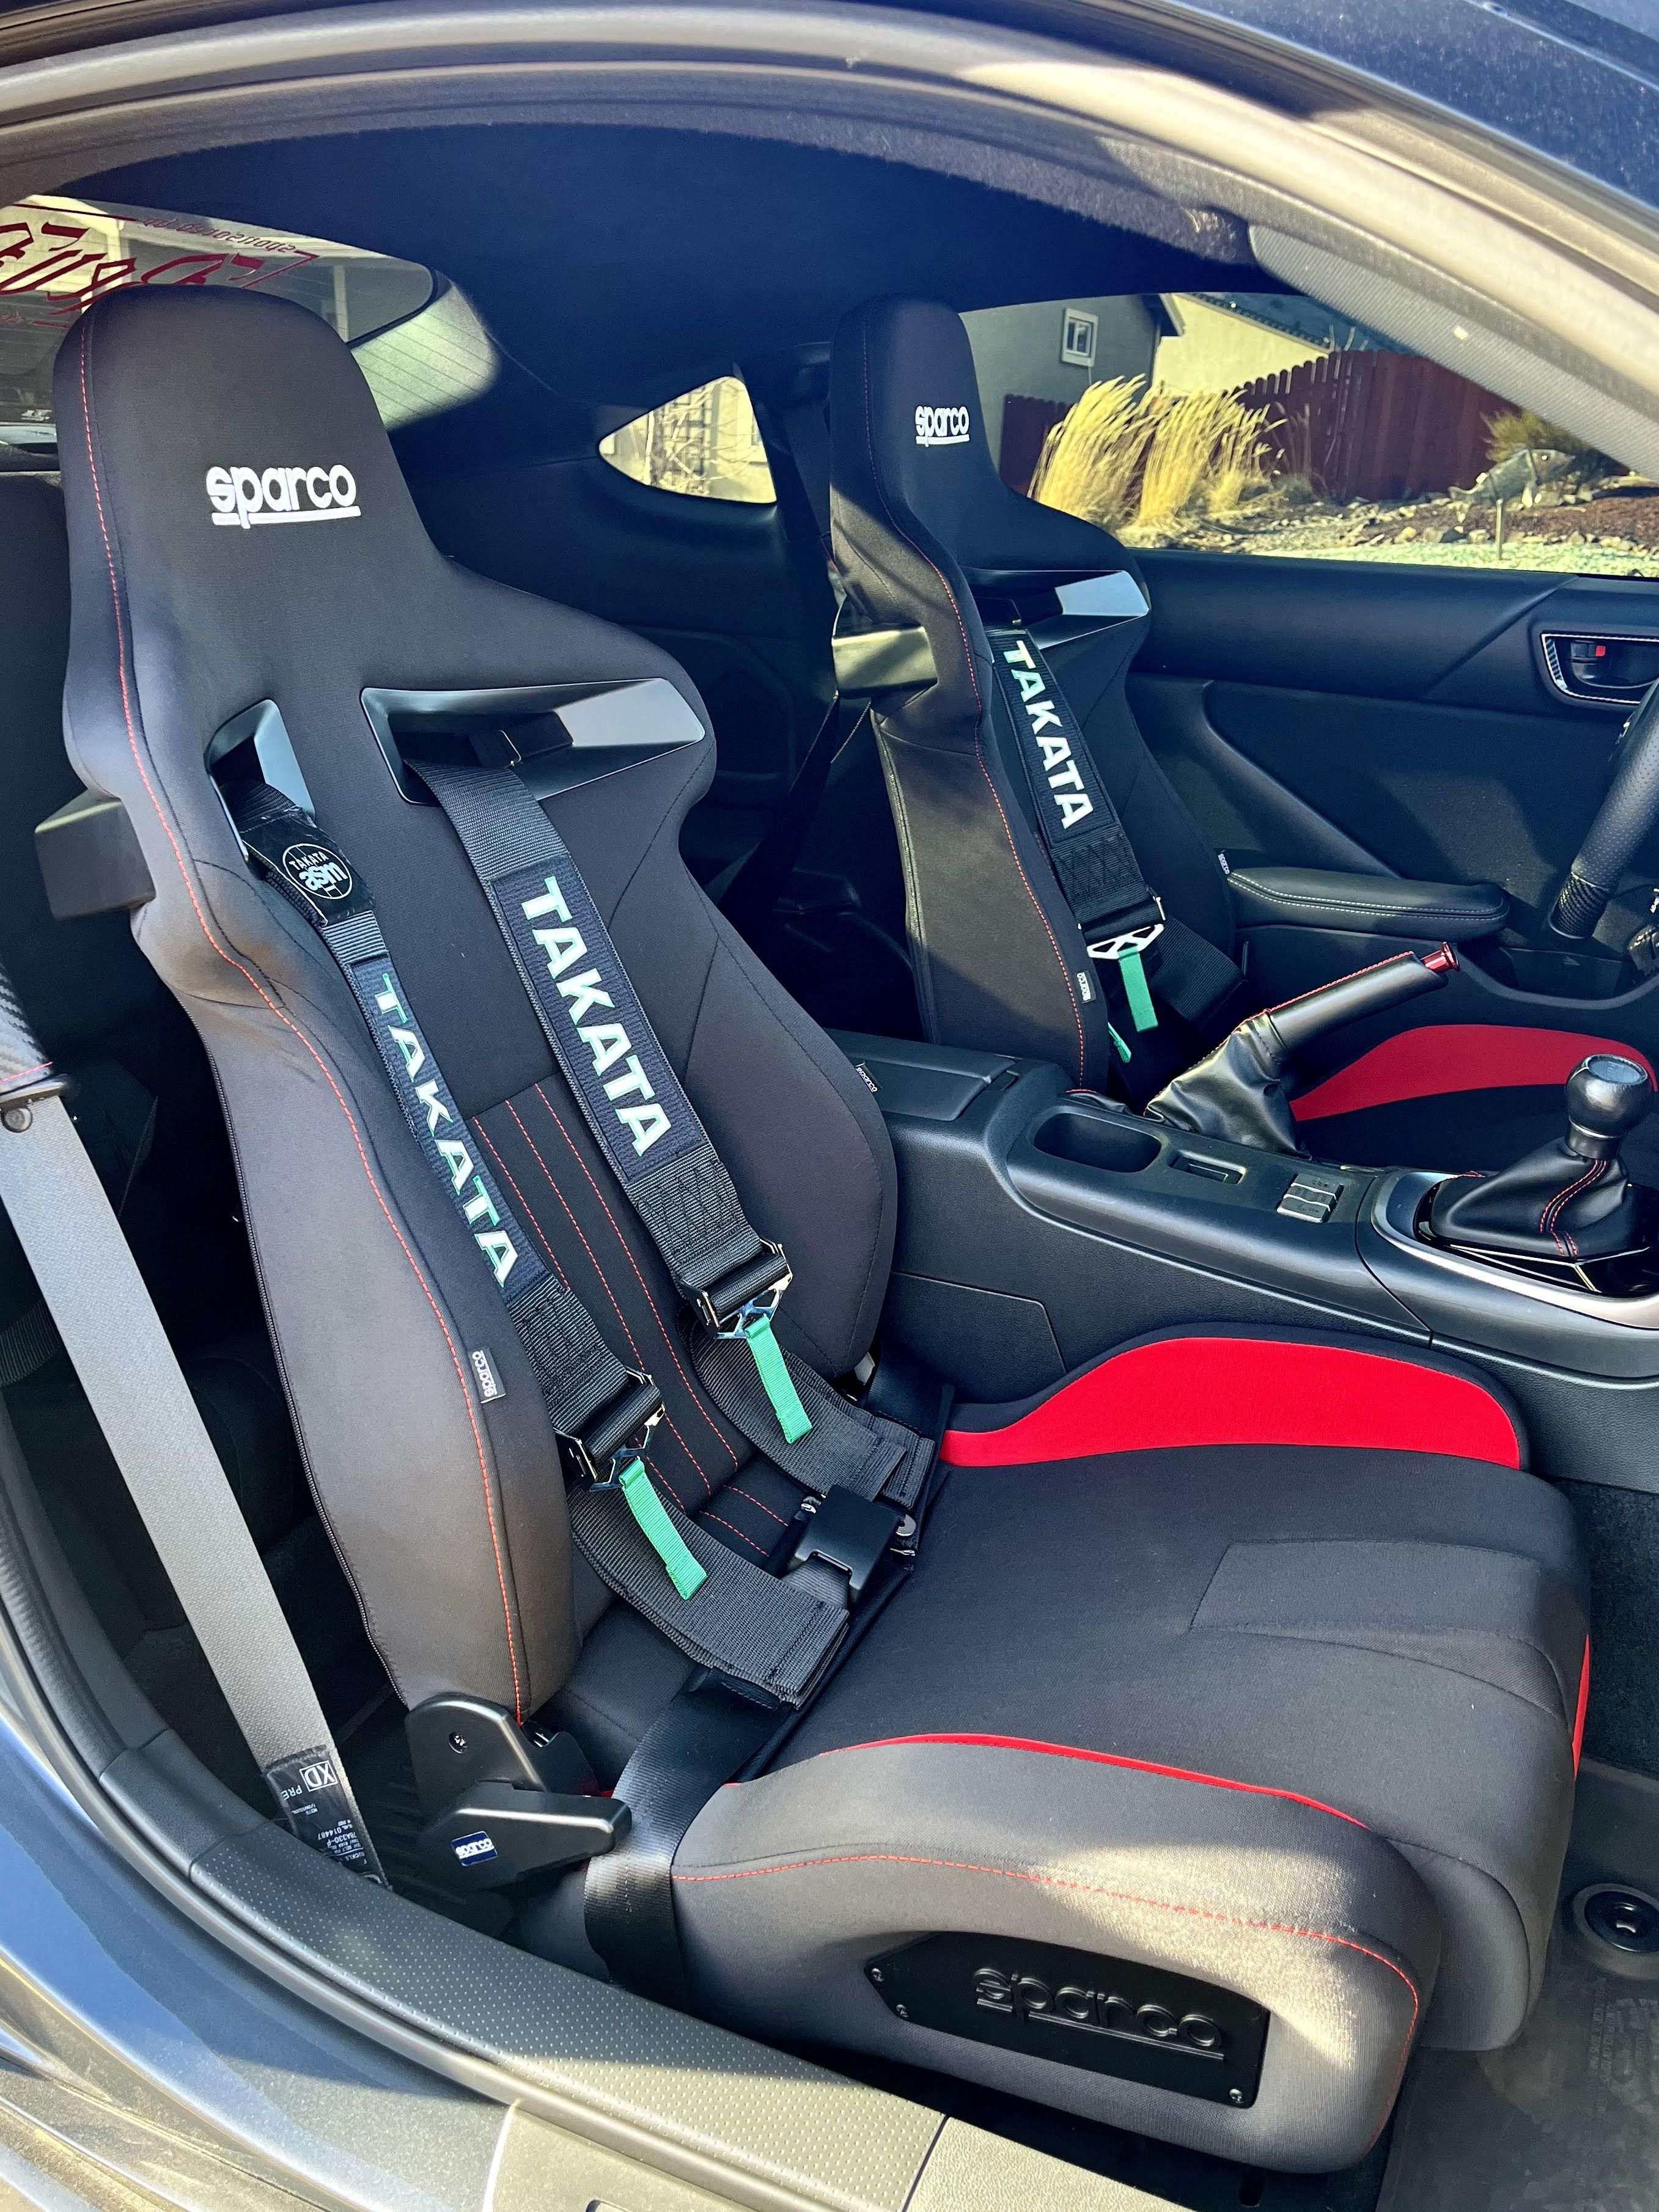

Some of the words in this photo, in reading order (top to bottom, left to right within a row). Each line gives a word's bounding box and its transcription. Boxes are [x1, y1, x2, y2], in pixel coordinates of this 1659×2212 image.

[916, 406, 970, 446] sparco
[207, 464, 360, 529] sparco
[1004, 640, 1094, 829] TAKATA
[289, 851, 329, 870] TAKATA
[521, 876, 672, 1157] TAKATA
[855, 1067, 878, 1093] sparco
[366, 973, 518, 1288] TAKATA
[472, 1350, 498, 1397] sparco
[281, 1785, 303, 1801] PRE
[304, 1763, 335, 1788] XD
[455, 1837, 495, 1859] sparco
[973, 1967, 1225, 2060] sparco
